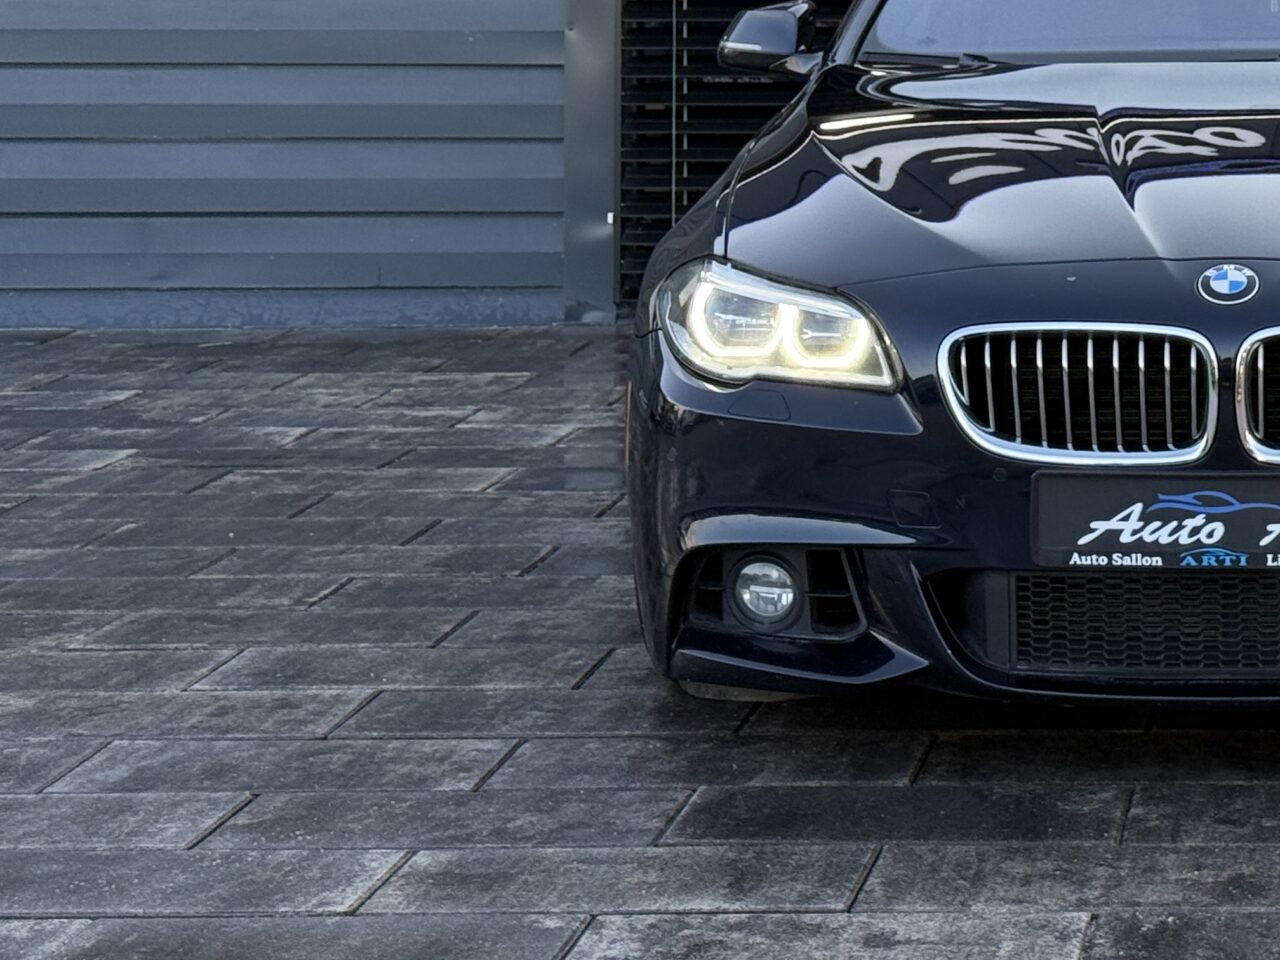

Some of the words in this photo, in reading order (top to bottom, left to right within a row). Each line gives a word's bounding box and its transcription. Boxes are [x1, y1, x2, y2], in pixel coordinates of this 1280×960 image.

[1077, 502, 1226, 546] Auto
[1069, 552, 1109, 566] Auto
[1111, 552, 1163, 566] Sallon
[1180, 555, 1249, 568] ARTI
